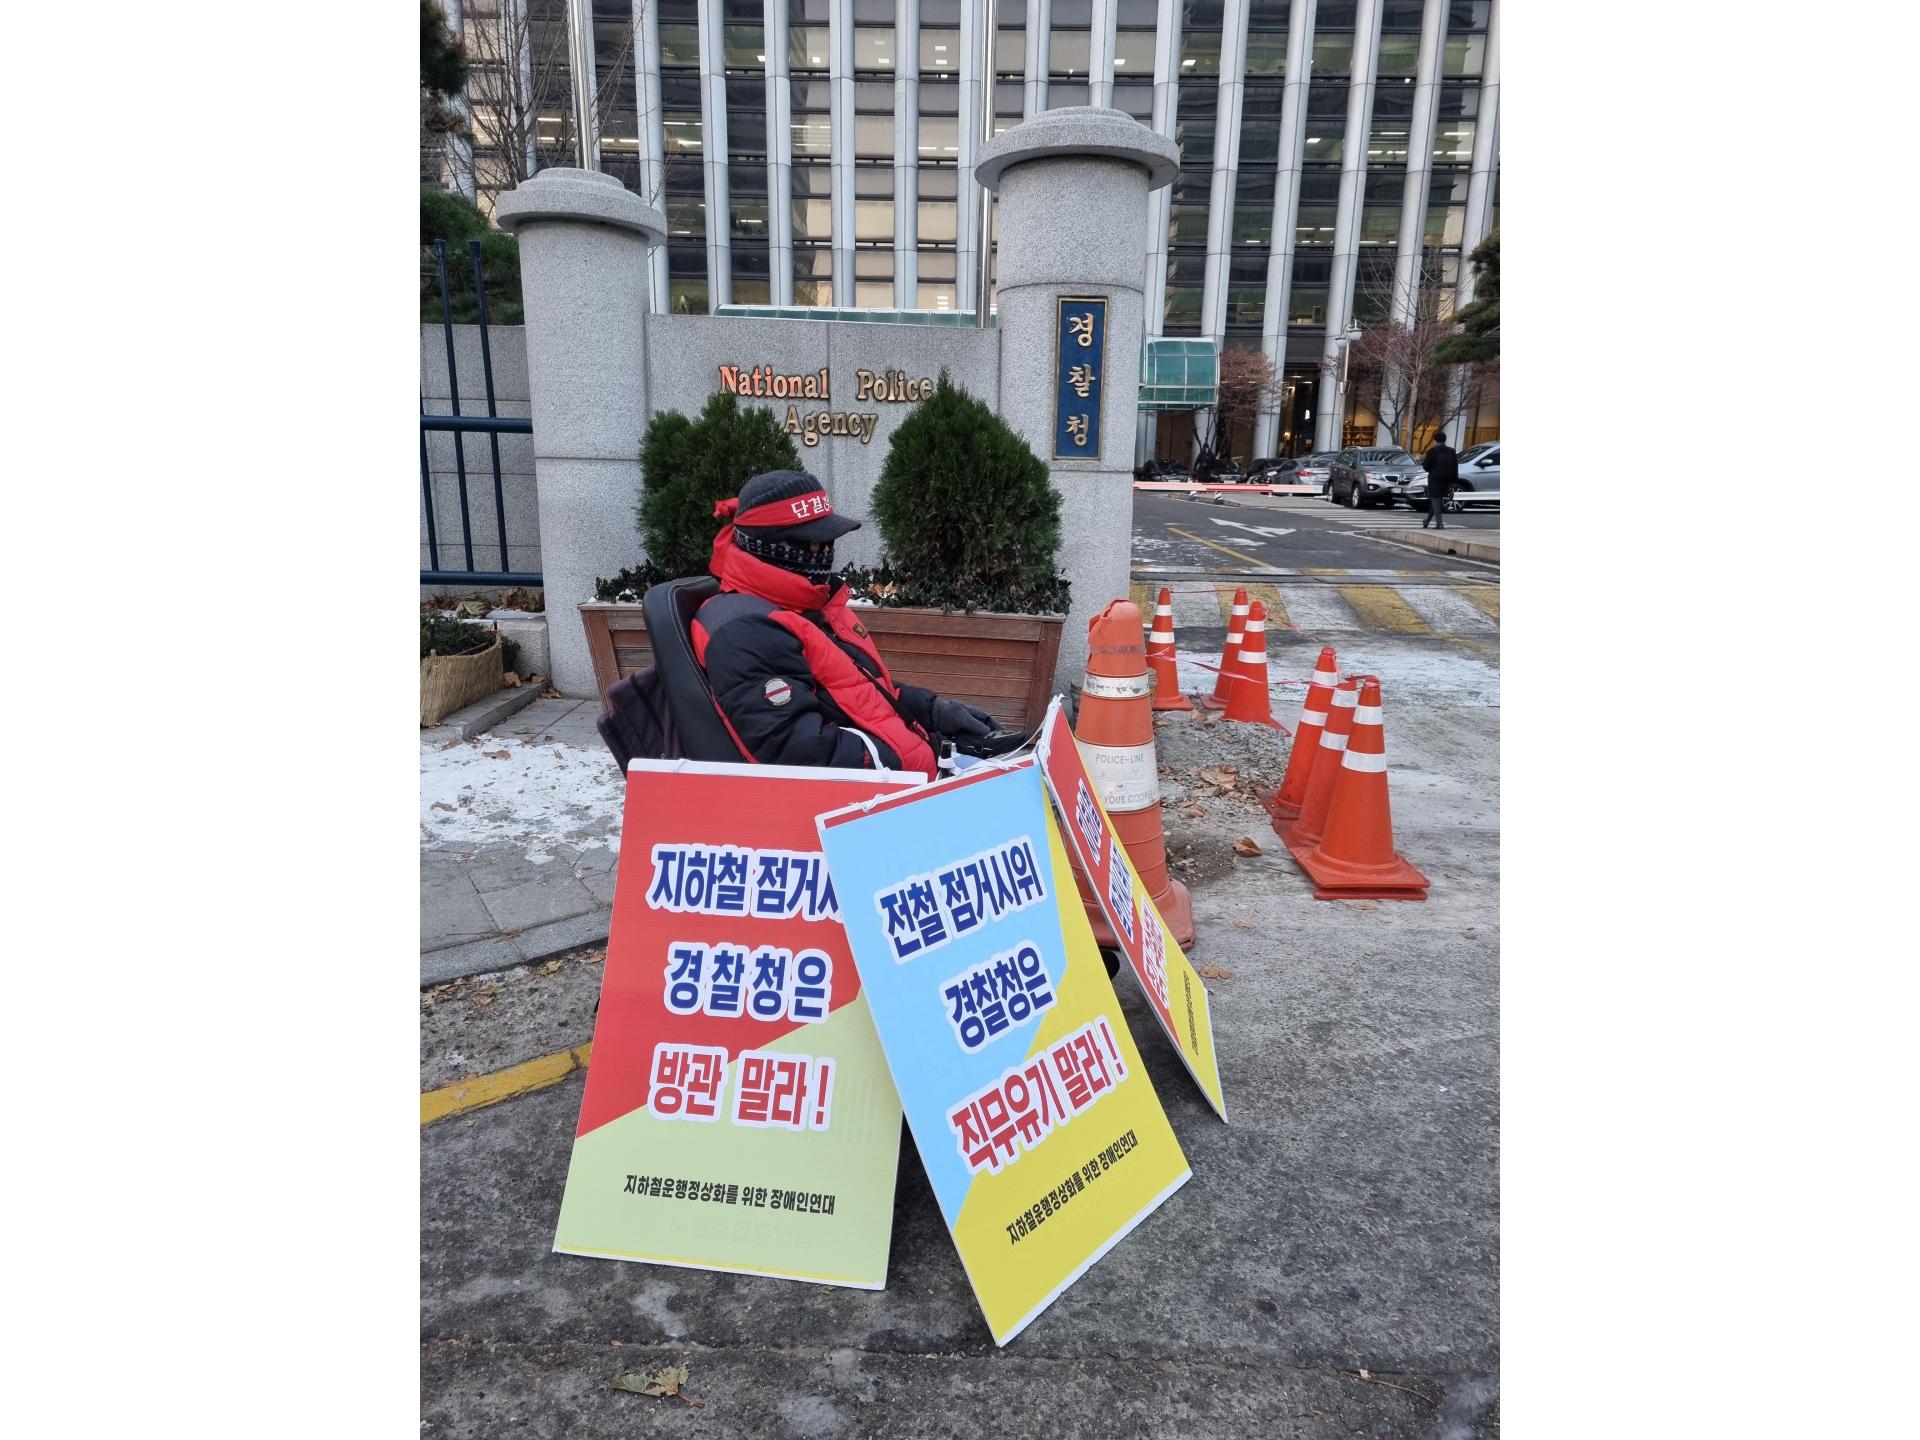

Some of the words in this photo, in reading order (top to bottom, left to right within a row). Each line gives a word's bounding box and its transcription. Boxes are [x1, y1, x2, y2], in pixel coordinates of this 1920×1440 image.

[719, 365, 830, 399] National
[856, 370, 934, 401] Police
[1064, 311, 1097, 447] 경찰청
[783, 405, 879, 447] Agency
[651, 849, 749, 911] 지하철
[879, 879, 948, 959] 전철
[939, 842, 1044, 934] 점거시위
[669, 948, 828, 1019] 경찰청은
[944, 946, 1054, 1049] 경찰청은
[653, 1050, 723, 1117] 방관
[951, 1058, 1067, 1169] 직무유기
[623, 1174, 740, 1206] 지하철운행정상화를
[740, 1186, 768, 1208] 위한
[769, 1188, 837, 1216] 장애인연대
[1005, 1171, 1086, 1246] 지하철운행정상화를
[1081, 1157, 1102, 1184] 위한
[1097, 1128, 1139, 1171] 장애인연대
